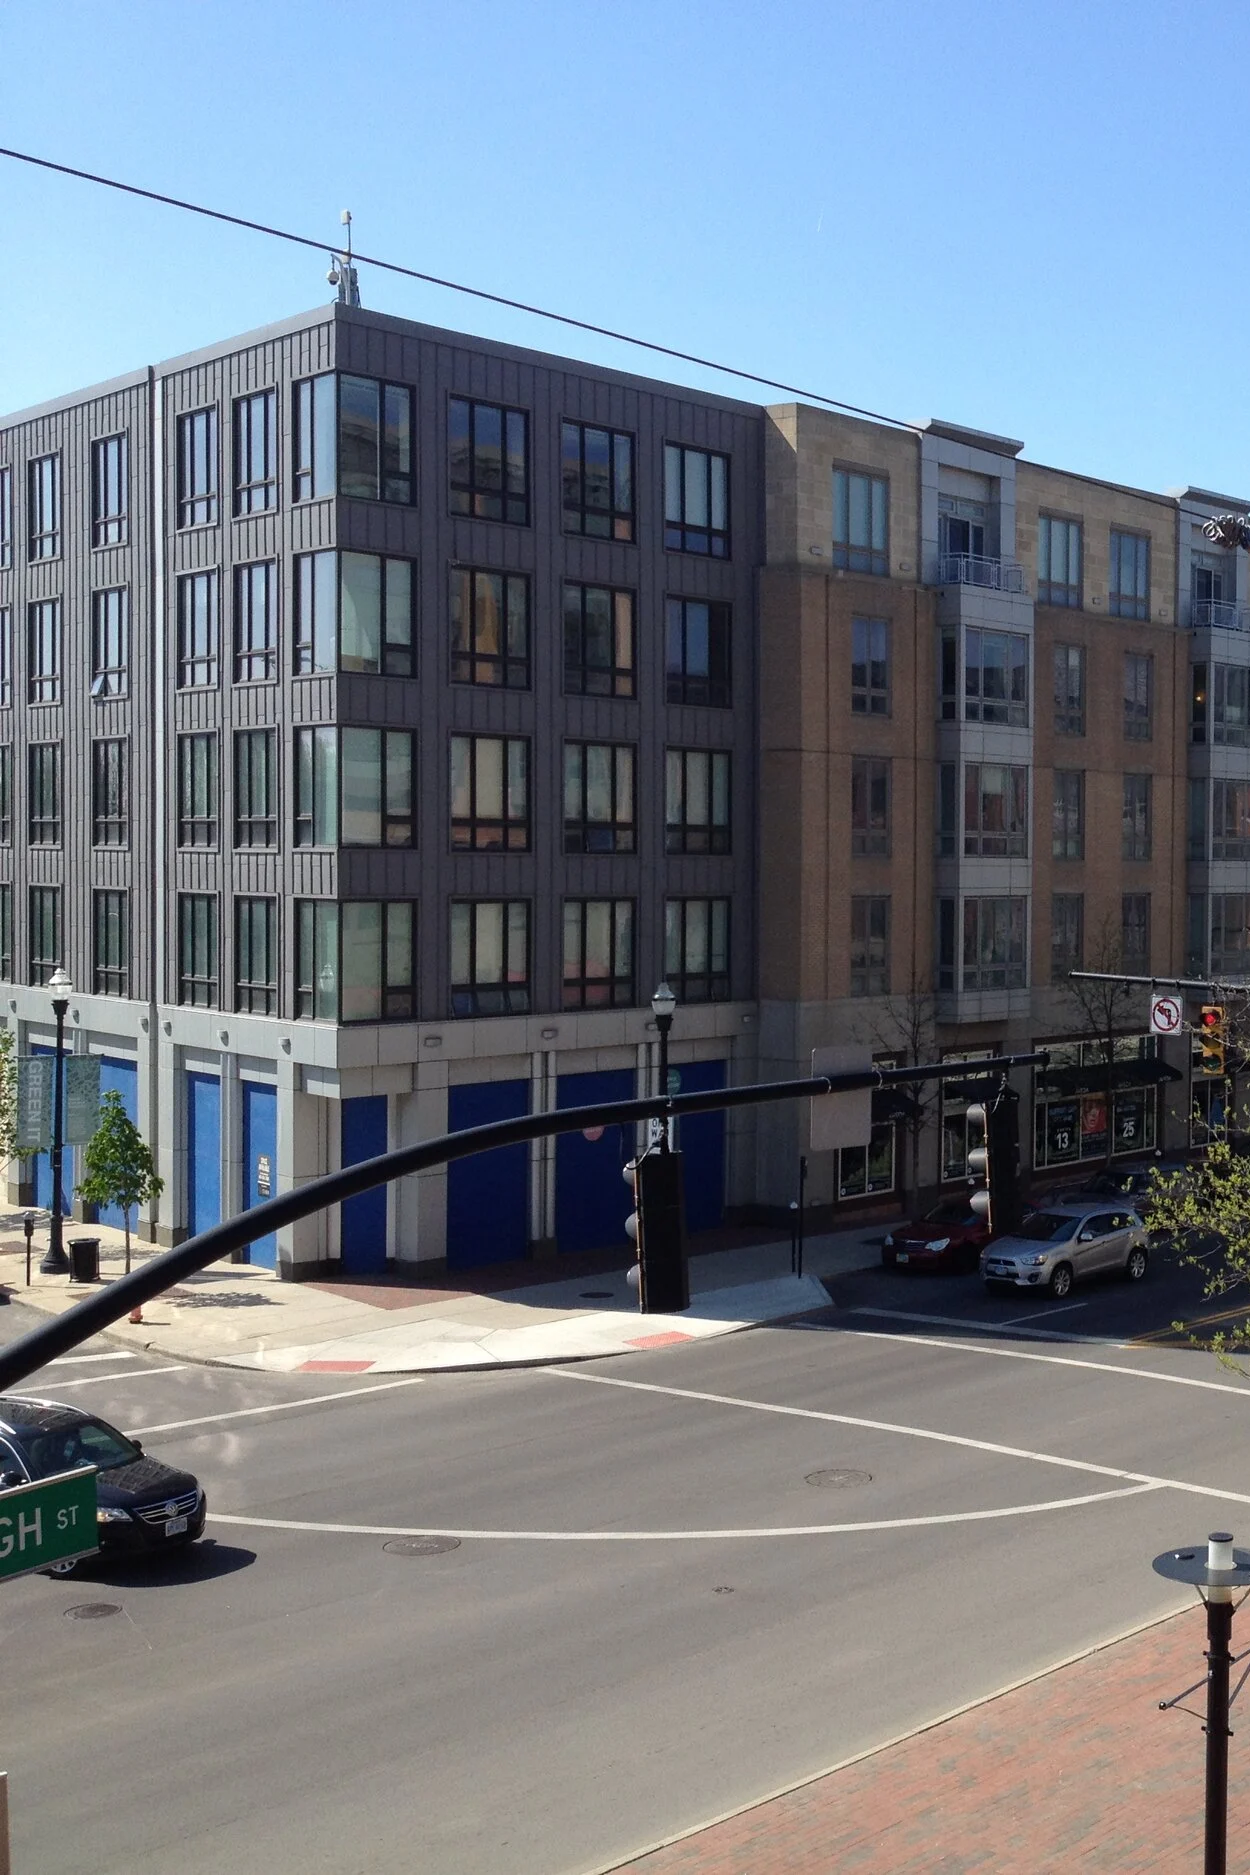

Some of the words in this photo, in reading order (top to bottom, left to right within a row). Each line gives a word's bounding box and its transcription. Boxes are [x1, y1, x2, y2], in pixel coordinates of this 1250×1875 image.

[28, 1061, 43, 1122] GREEN
[28, 1127, 41, 1142] IT
[1122, 1121, 1135, 1138] 25
[1056, 1131, 1069, 1149] 13
[56, 1505, 80, 1530] ST
